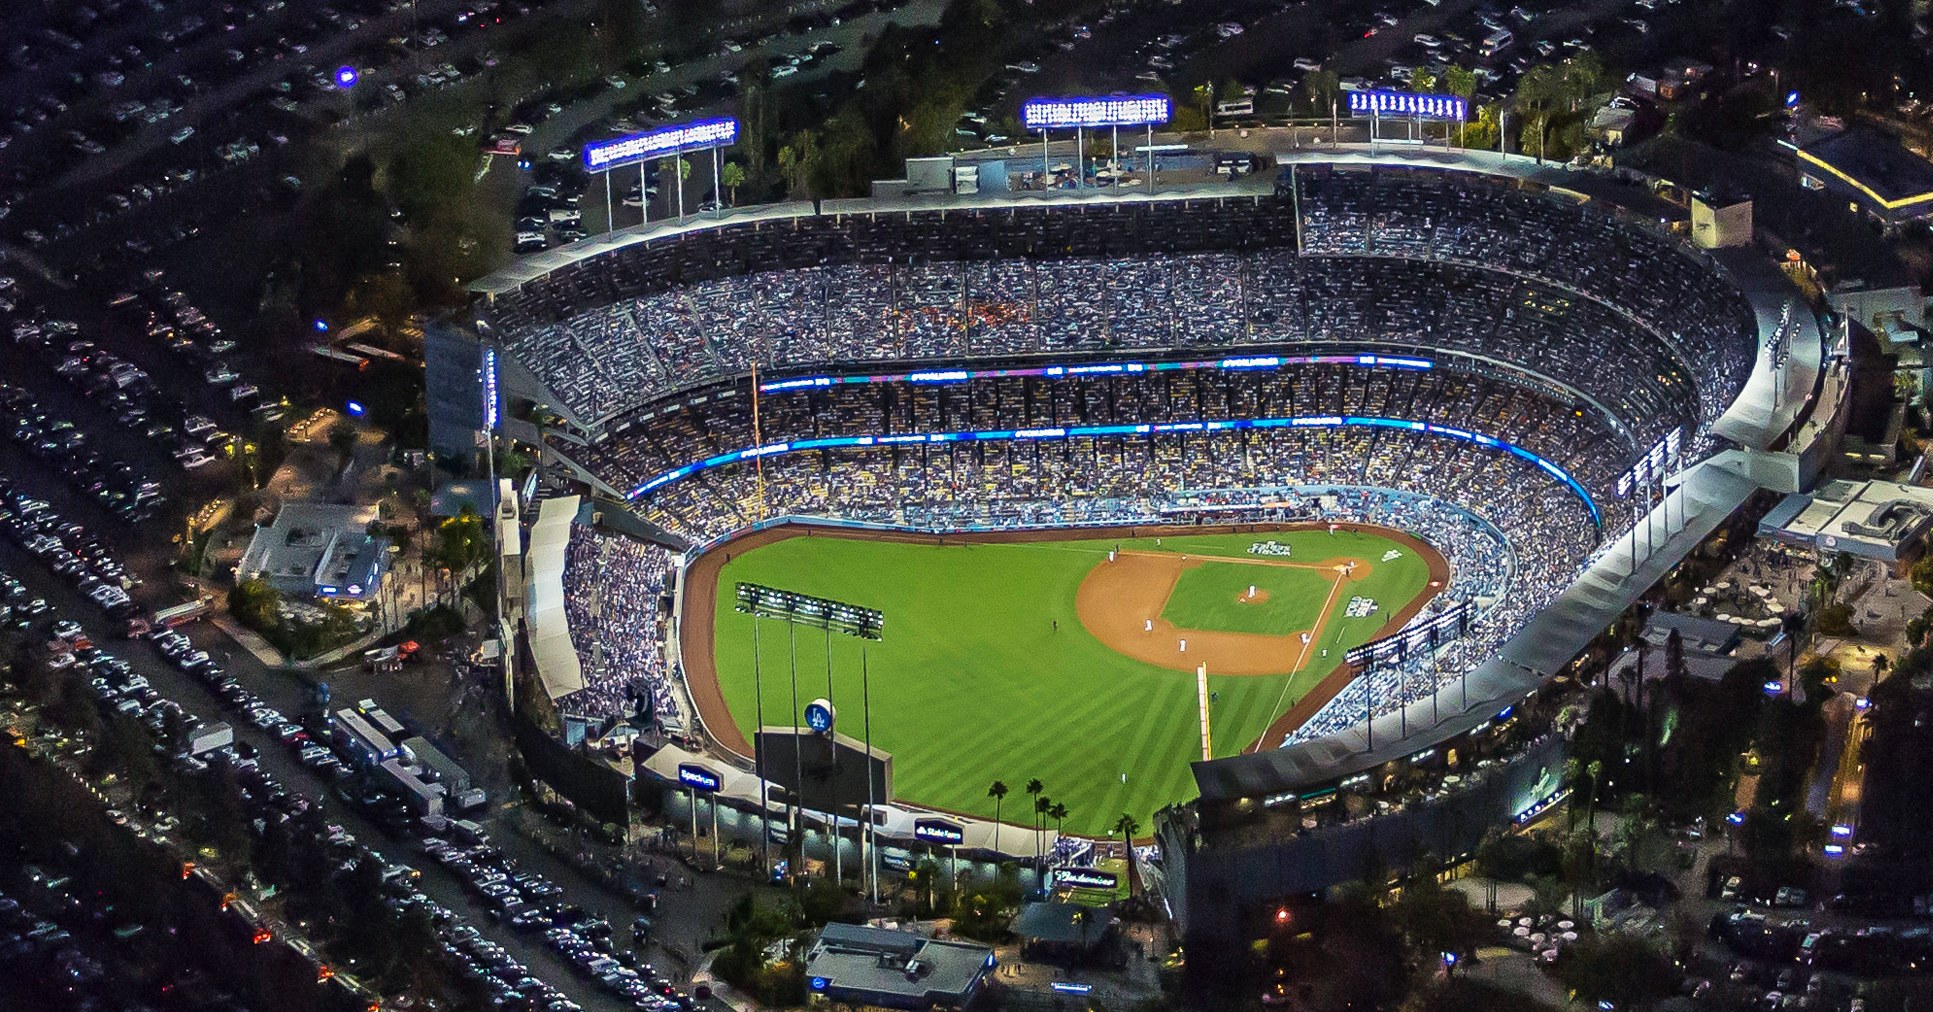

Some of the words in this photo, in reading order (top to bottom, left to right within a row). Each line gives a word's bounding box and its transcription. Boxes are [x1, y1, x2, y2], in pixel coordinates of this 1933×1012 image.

[812, 708, 825, 728] LA
[681, 769, 715, 787] Spectrum
[927, 827, 944, 837] State
[1055, 870, 1115, 885] Budweiser
